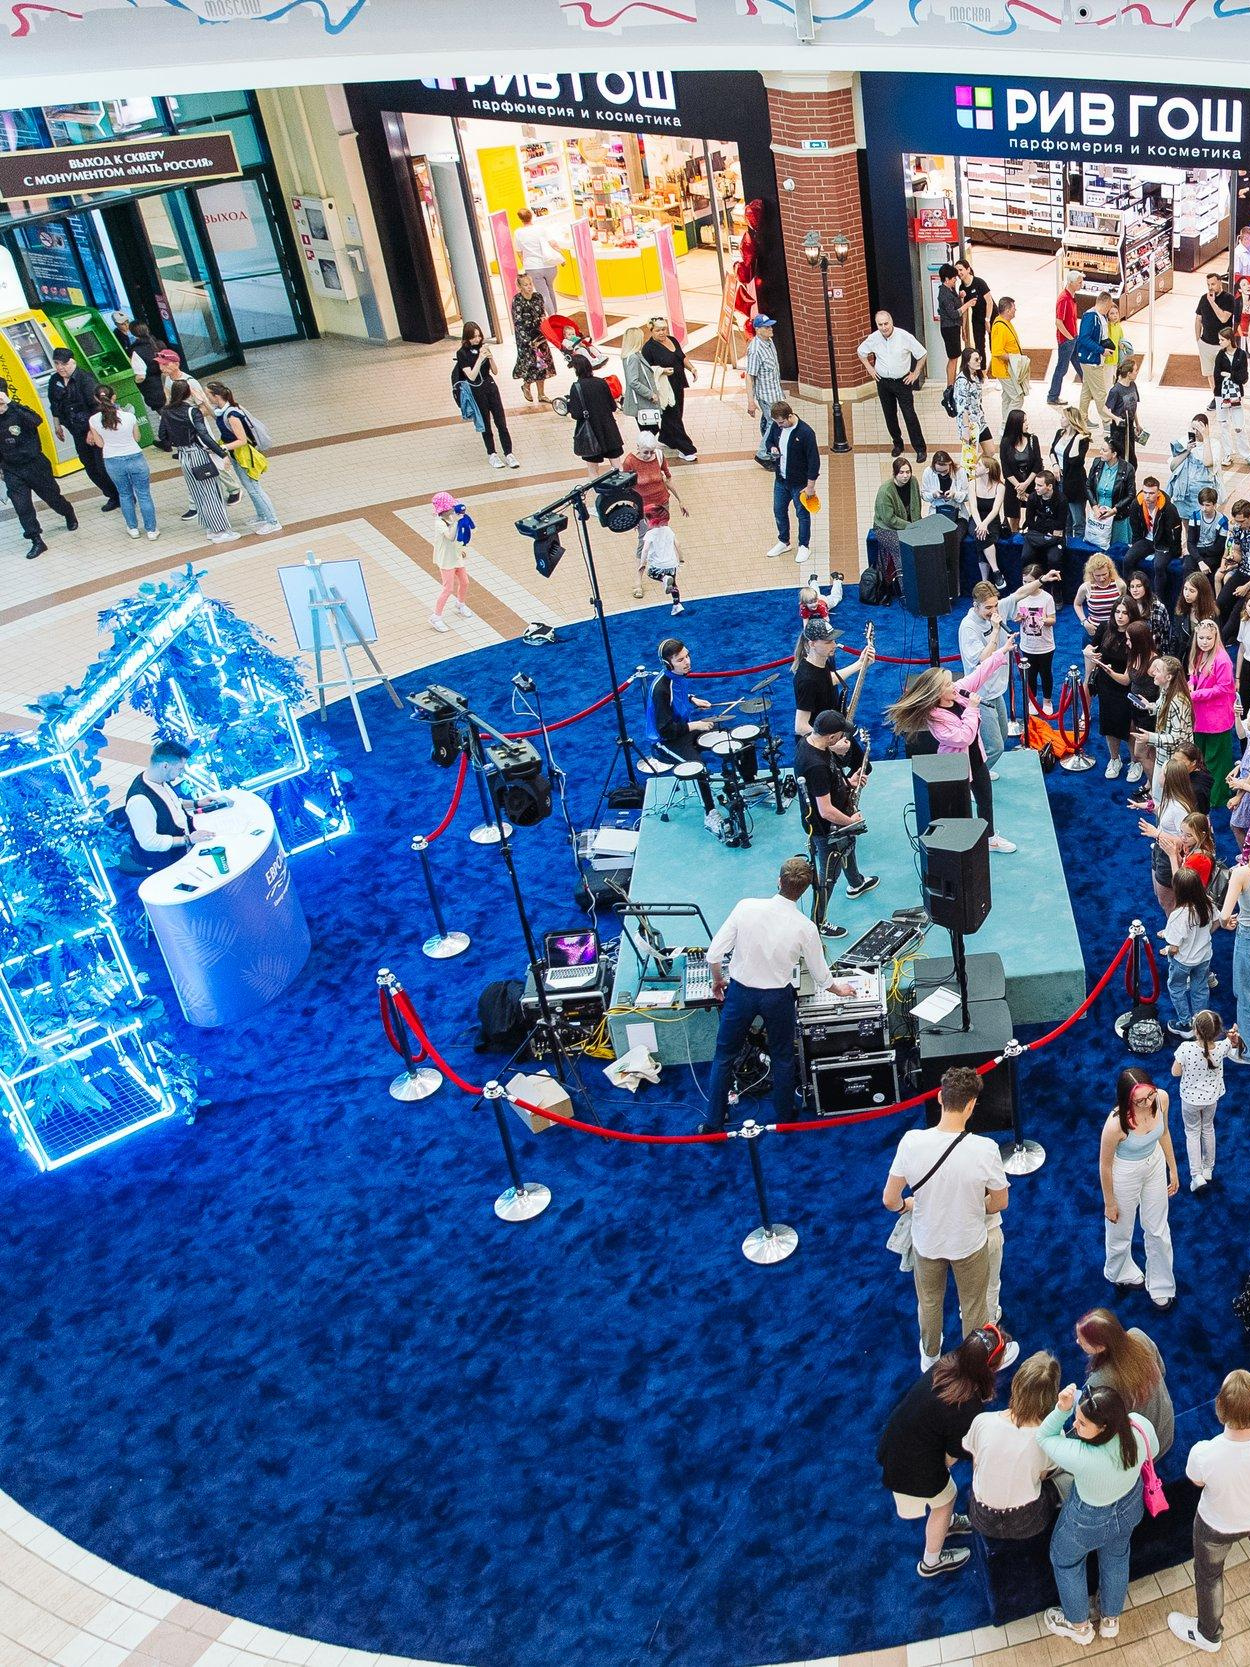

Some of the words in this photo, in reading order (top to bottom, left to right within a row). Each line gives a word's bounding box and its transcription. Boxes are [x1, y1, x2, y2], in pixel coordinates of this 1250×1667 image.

[949, 6, 991, 22] МОСКВА
[472, 99, 575, 118] парфюмерия
[581, 109, 590, 119] и
[595, 109, 682, 127] косметика
[1006, 88, 1115, 136] РИВ
[1129, 94, 1242, 143] ГОШ
[69, 156, 114, 169] ВЫХОД
[115, 153, 123, 165] К
[124, 150, 164, 162] СКВЕРУ
[1009, 138, 1123, 154] парфюмерия
[1130, 144, 1140, 154] и
[1148, 144, 1242, 160] косметика
[23, 177, 34, 187] С
[35, 167, 125, 186] МОНУМЕНТОМ
[127, 163, 163, 176] «МАТЬ
[164, 158, 213, 172] РОССИЯ»
